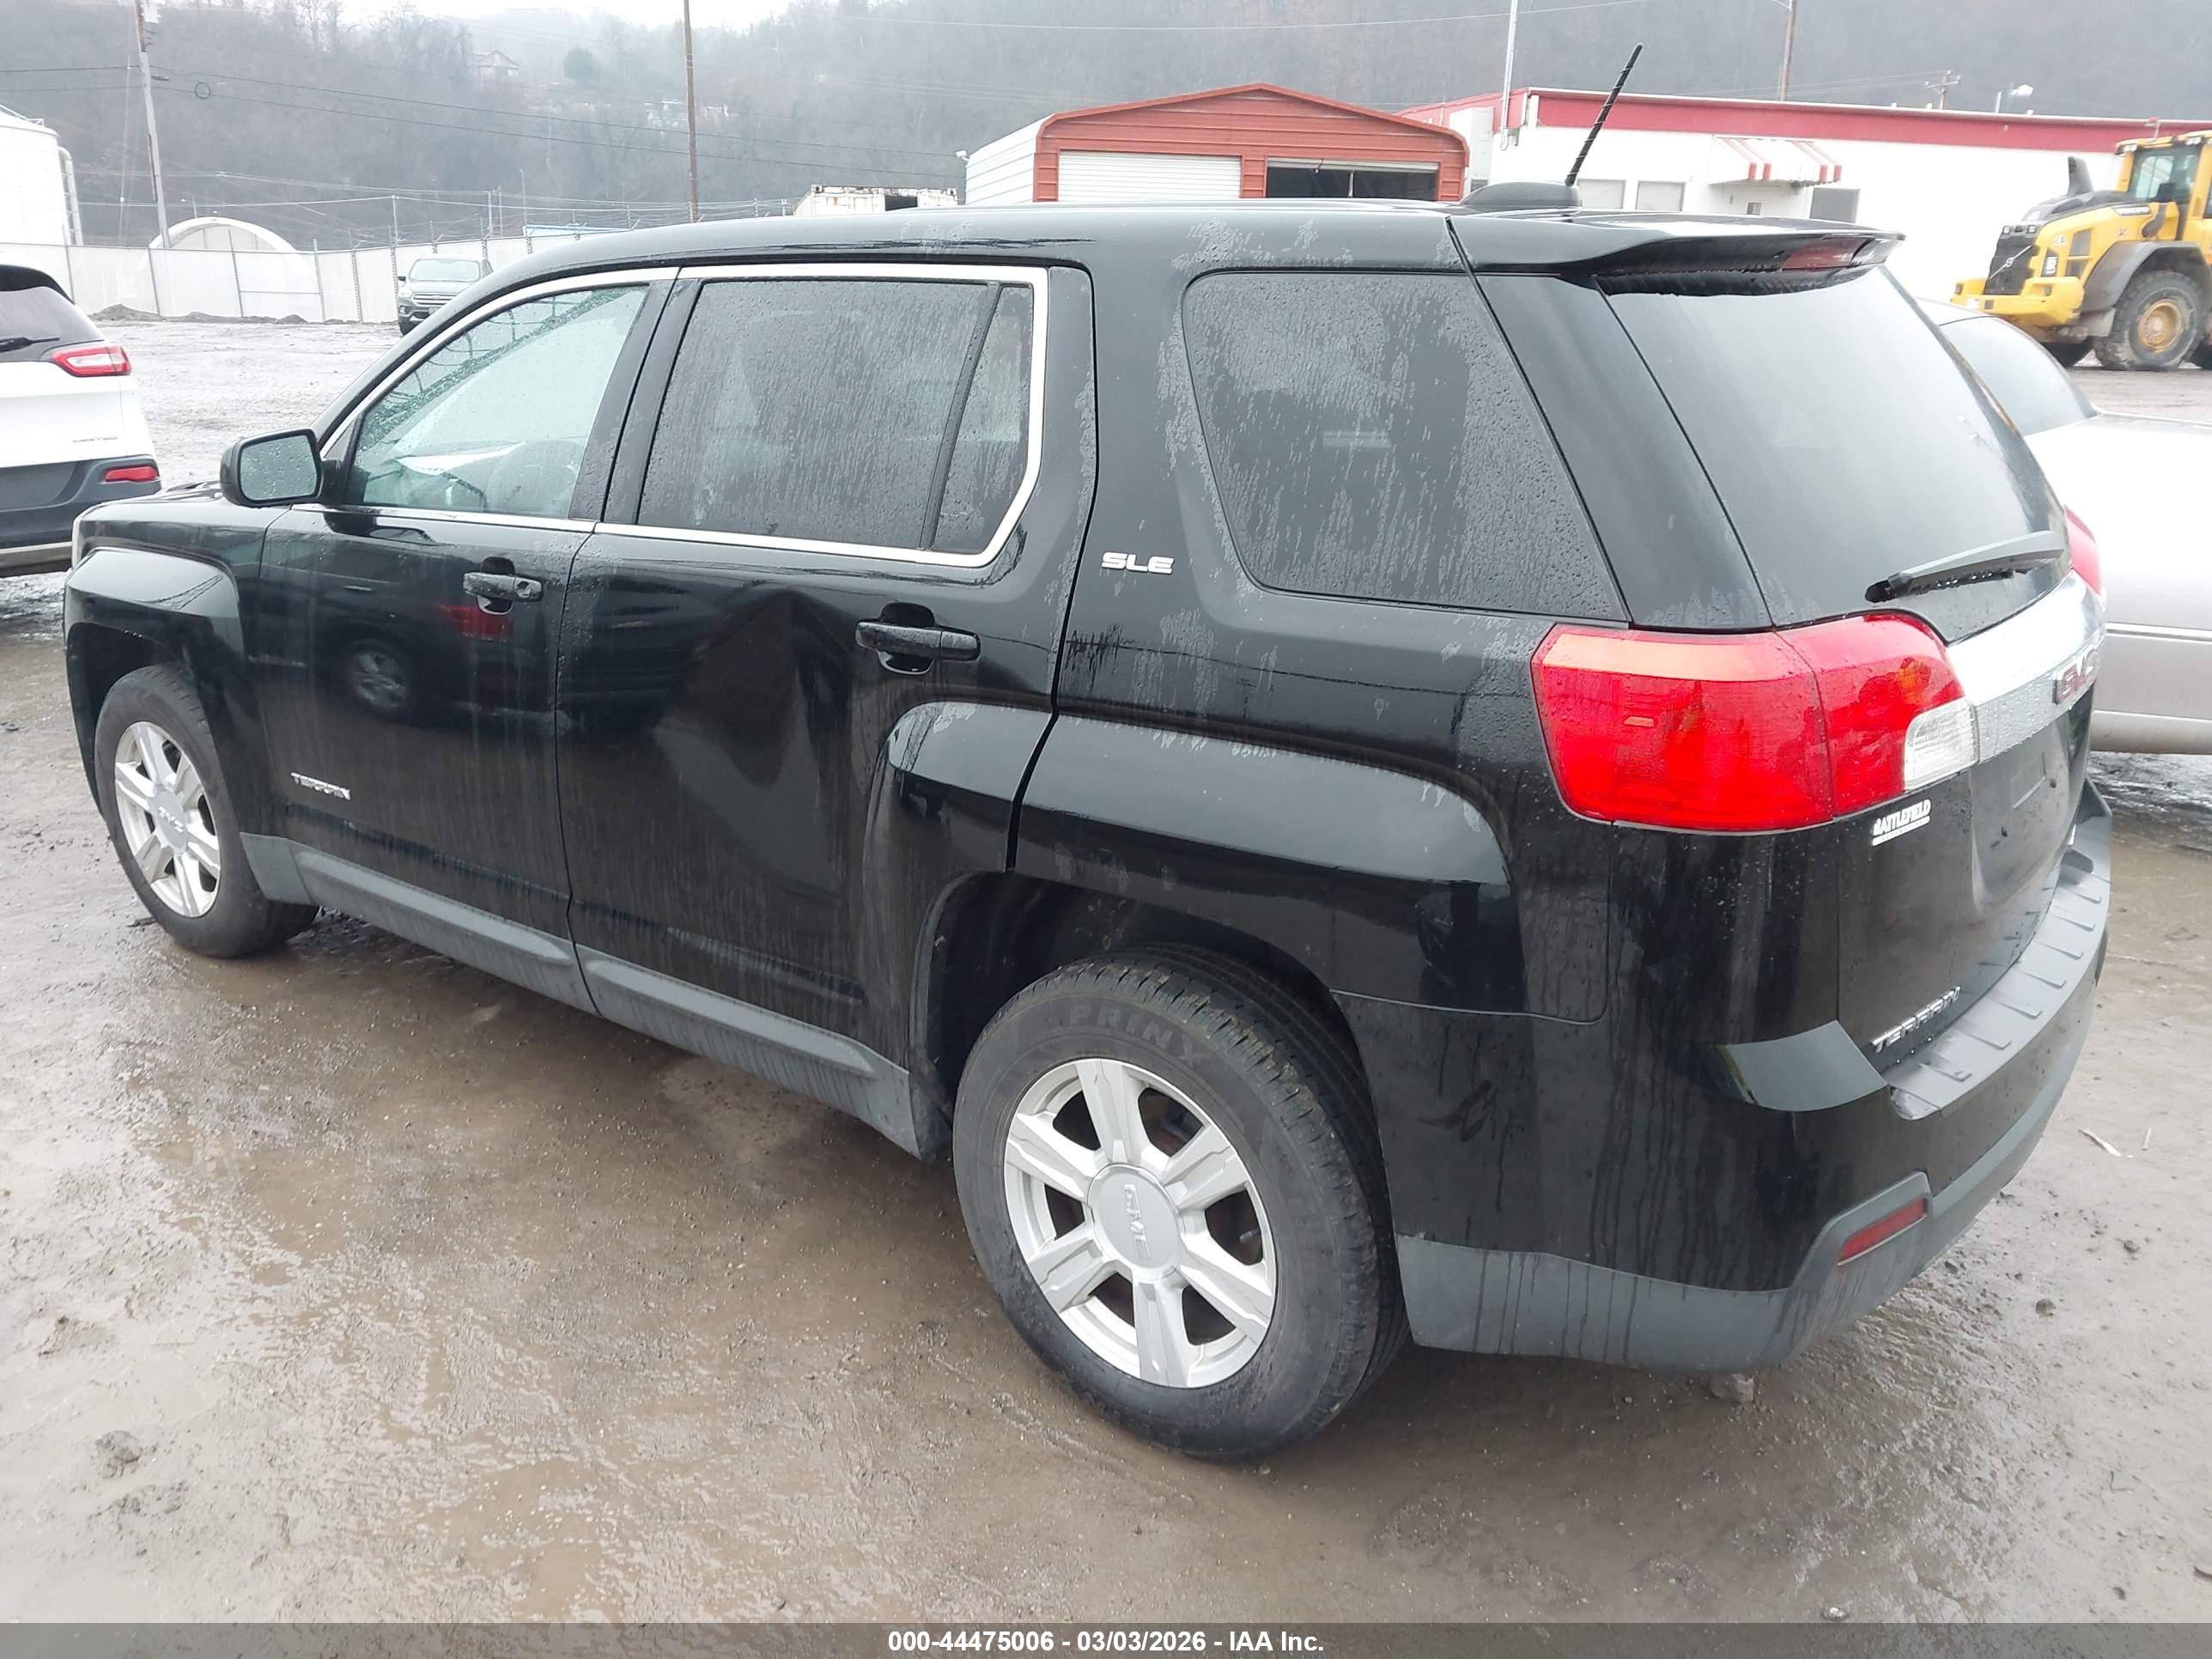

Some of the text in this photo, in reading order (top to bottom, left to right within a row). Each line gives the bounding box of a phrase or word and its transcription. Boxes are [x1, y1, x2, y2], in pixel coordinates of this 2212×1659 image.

[1101, 551, 1175, 574] SLE
[1872, 799, 1931, 836] BATTLEFIELD
[1068, 1002, 1212, 1068] PRINX
[1870, 986, 1961, 1054] TERRAIN
